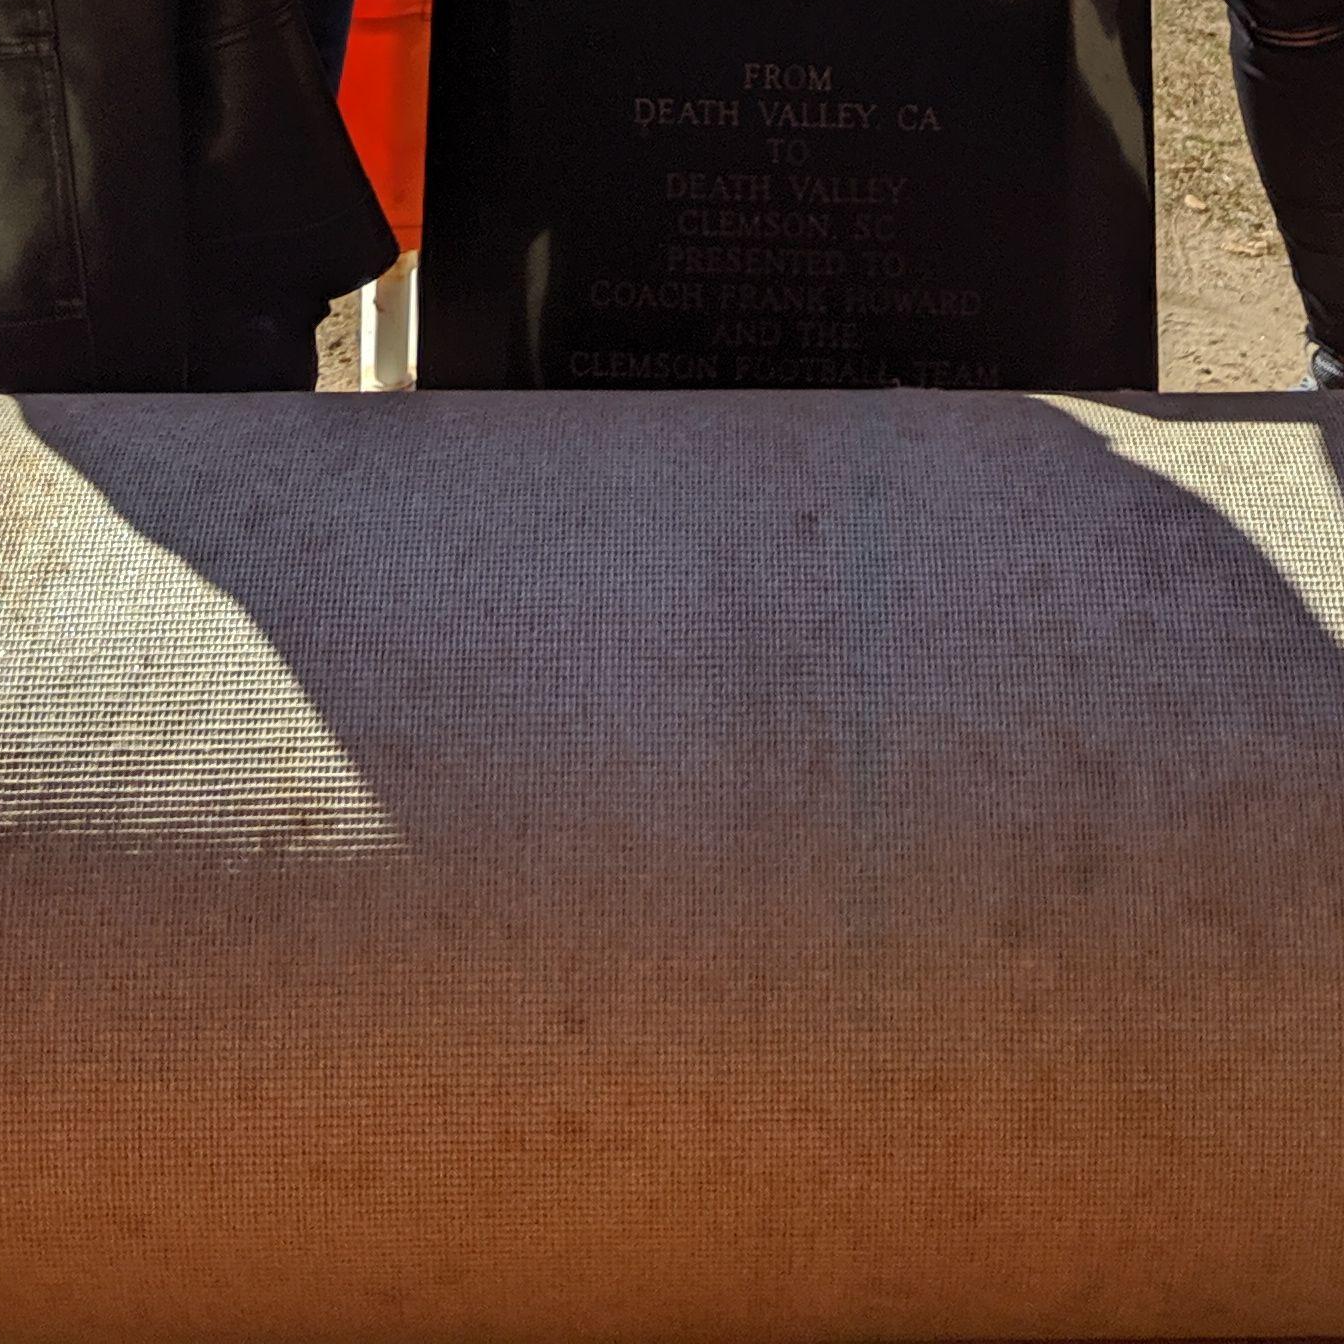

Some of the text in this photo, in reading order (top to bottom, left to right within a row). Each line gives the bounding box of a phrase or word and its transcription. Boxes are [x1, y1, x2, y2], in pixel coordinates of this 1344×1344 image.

[743, 62, 834, 92] FROM
[633, 97, 740, 127] DEATH
[897, 103, 942, 132] CA
[766, 137, 810, 166] TO
[666, 172, 771, 201] DEATH
[666, 245, 906, 278] PRESENTED TO
[589, 279, 983, 317] COACH FRANK HOWARD
[712, 321, 862, 350] AND THE
[569, 350, 720, 381] CLEMSON
